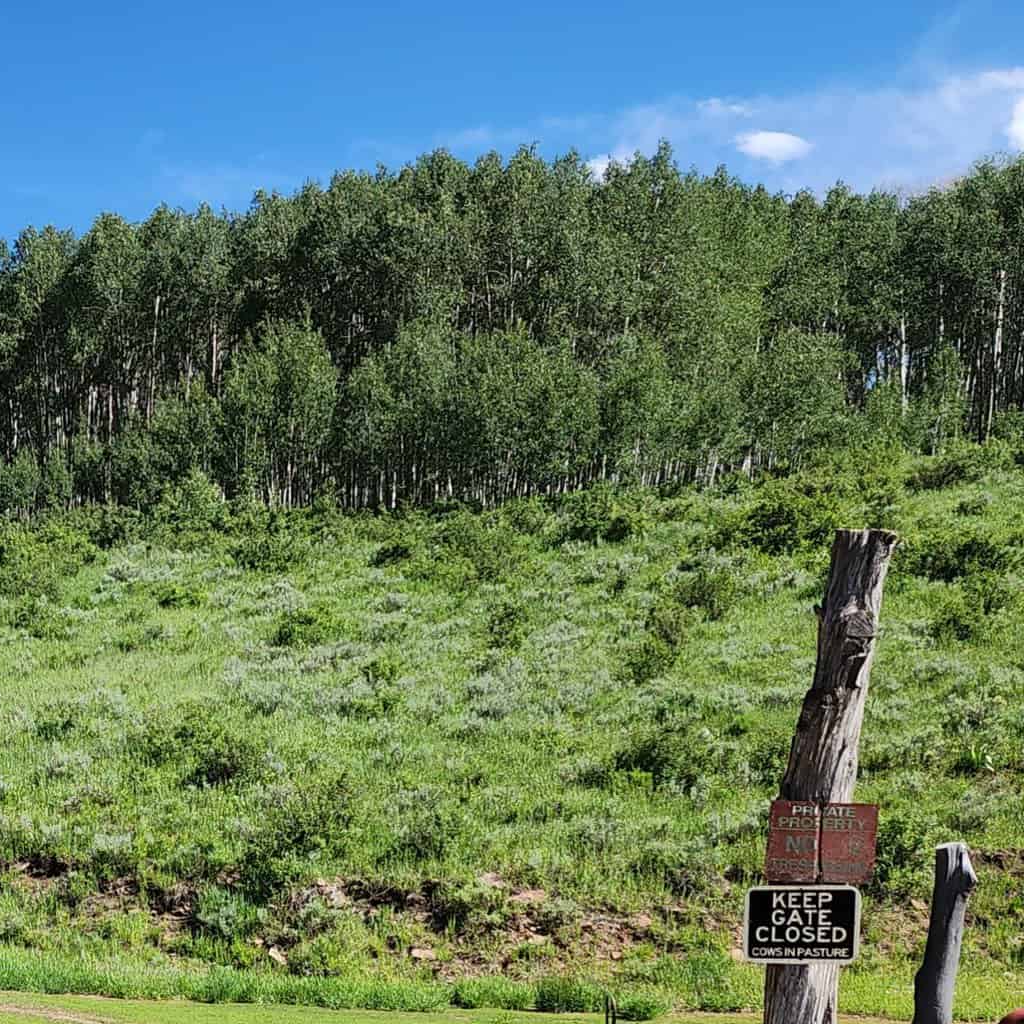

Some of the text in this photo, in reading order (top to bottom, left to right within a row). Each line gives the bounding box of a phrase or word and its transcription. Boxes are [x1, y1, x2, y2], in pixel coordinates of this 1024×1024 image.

[778, 816, 865, 830] PROERTY
[772, 892, 833, 908] KEEP
[771, 909, 833, 926] GATE
[755, 926, 847, 943] CLOSED
[751, 947, 849, 958] COWS IN PASTURE
